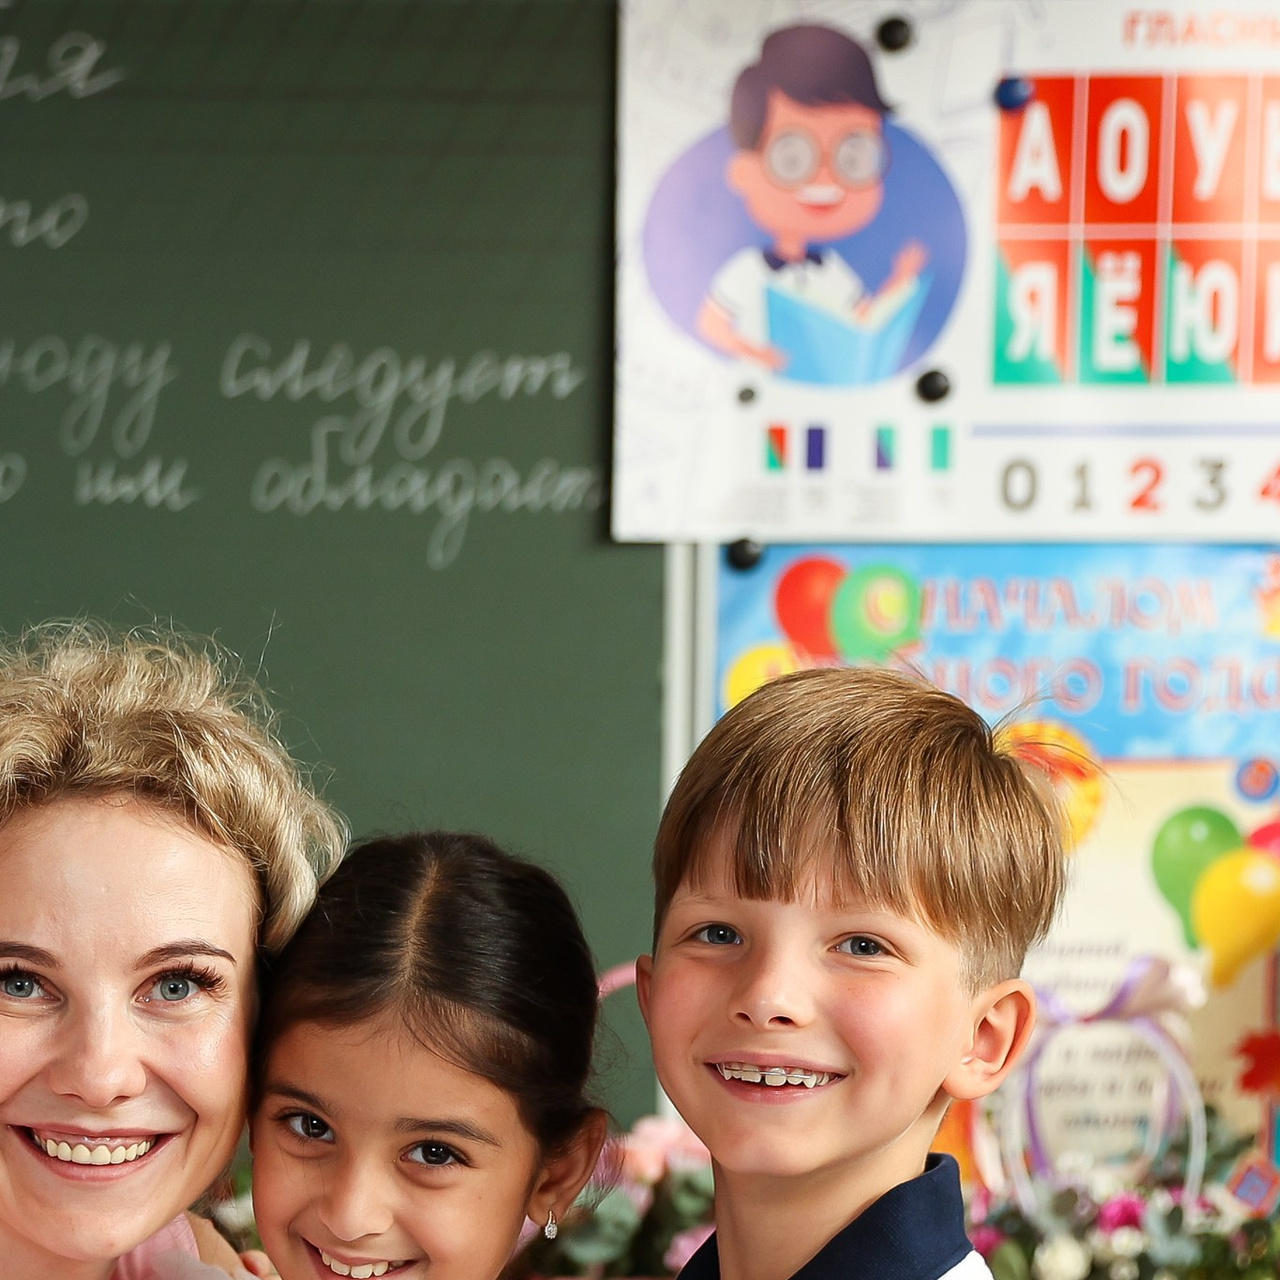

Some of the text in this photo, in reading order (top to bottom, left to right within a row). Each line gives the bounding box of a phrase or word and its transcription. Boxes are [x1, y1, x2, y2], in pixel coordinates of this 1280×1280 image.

[1009, 101, 1062, 202] А
[1186, 101, 1240, 201] У
[1006, 261, 1058, 362] Я
[1094, 252, 1142, 370] Ё
[1171, 260, 1239, 364] Ю
[221, 333, 586, 466] следует
[73, 455, 201, 512] им
[1073, 460, 1091, 511] 1
[1129, 456, 1163, 511] 2
[1195, 457, 1226, 512] 3
